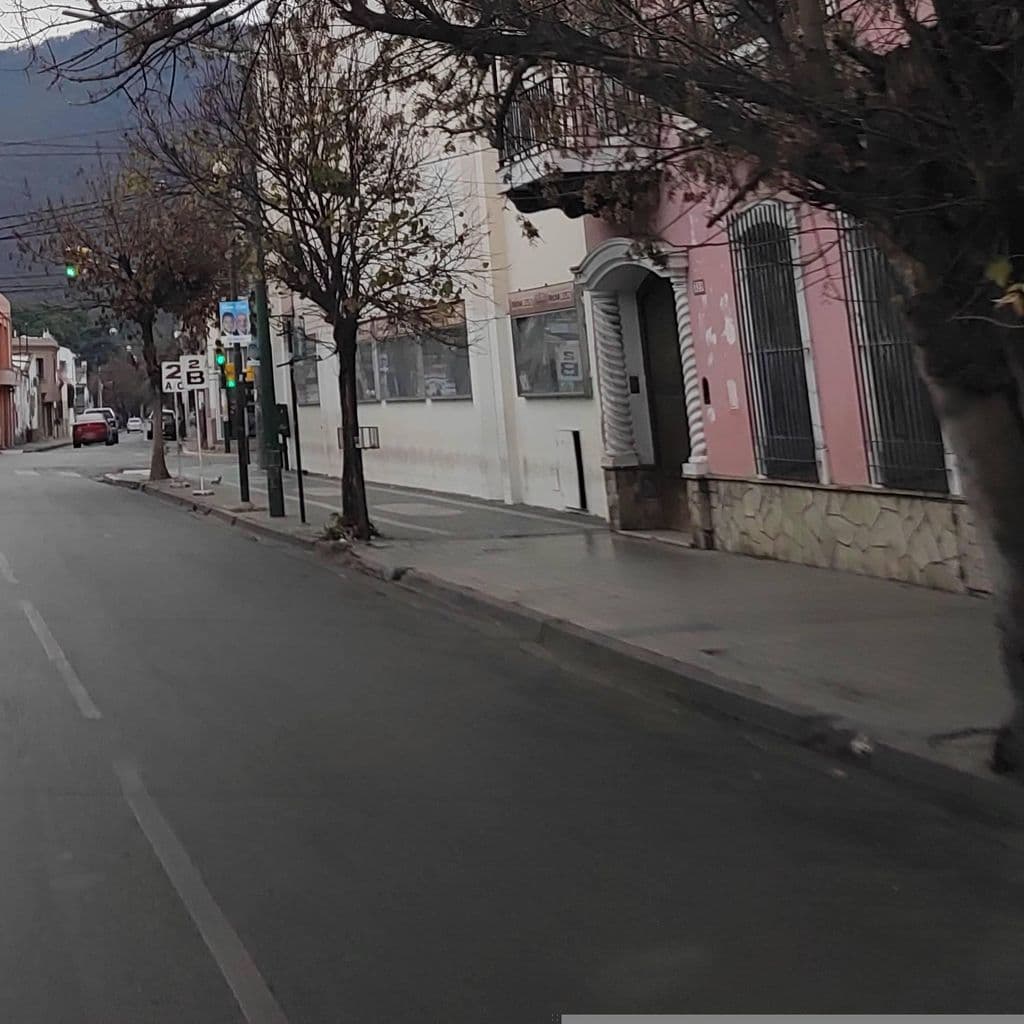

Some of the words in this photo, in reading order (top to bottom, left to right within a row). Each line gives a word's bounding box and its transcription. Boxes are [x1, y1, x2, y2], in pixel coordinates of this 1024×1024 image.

[166, 364, 181, 379] 2
[188, 360, 200, 368] 2
[186, 370, 205, 385] B
